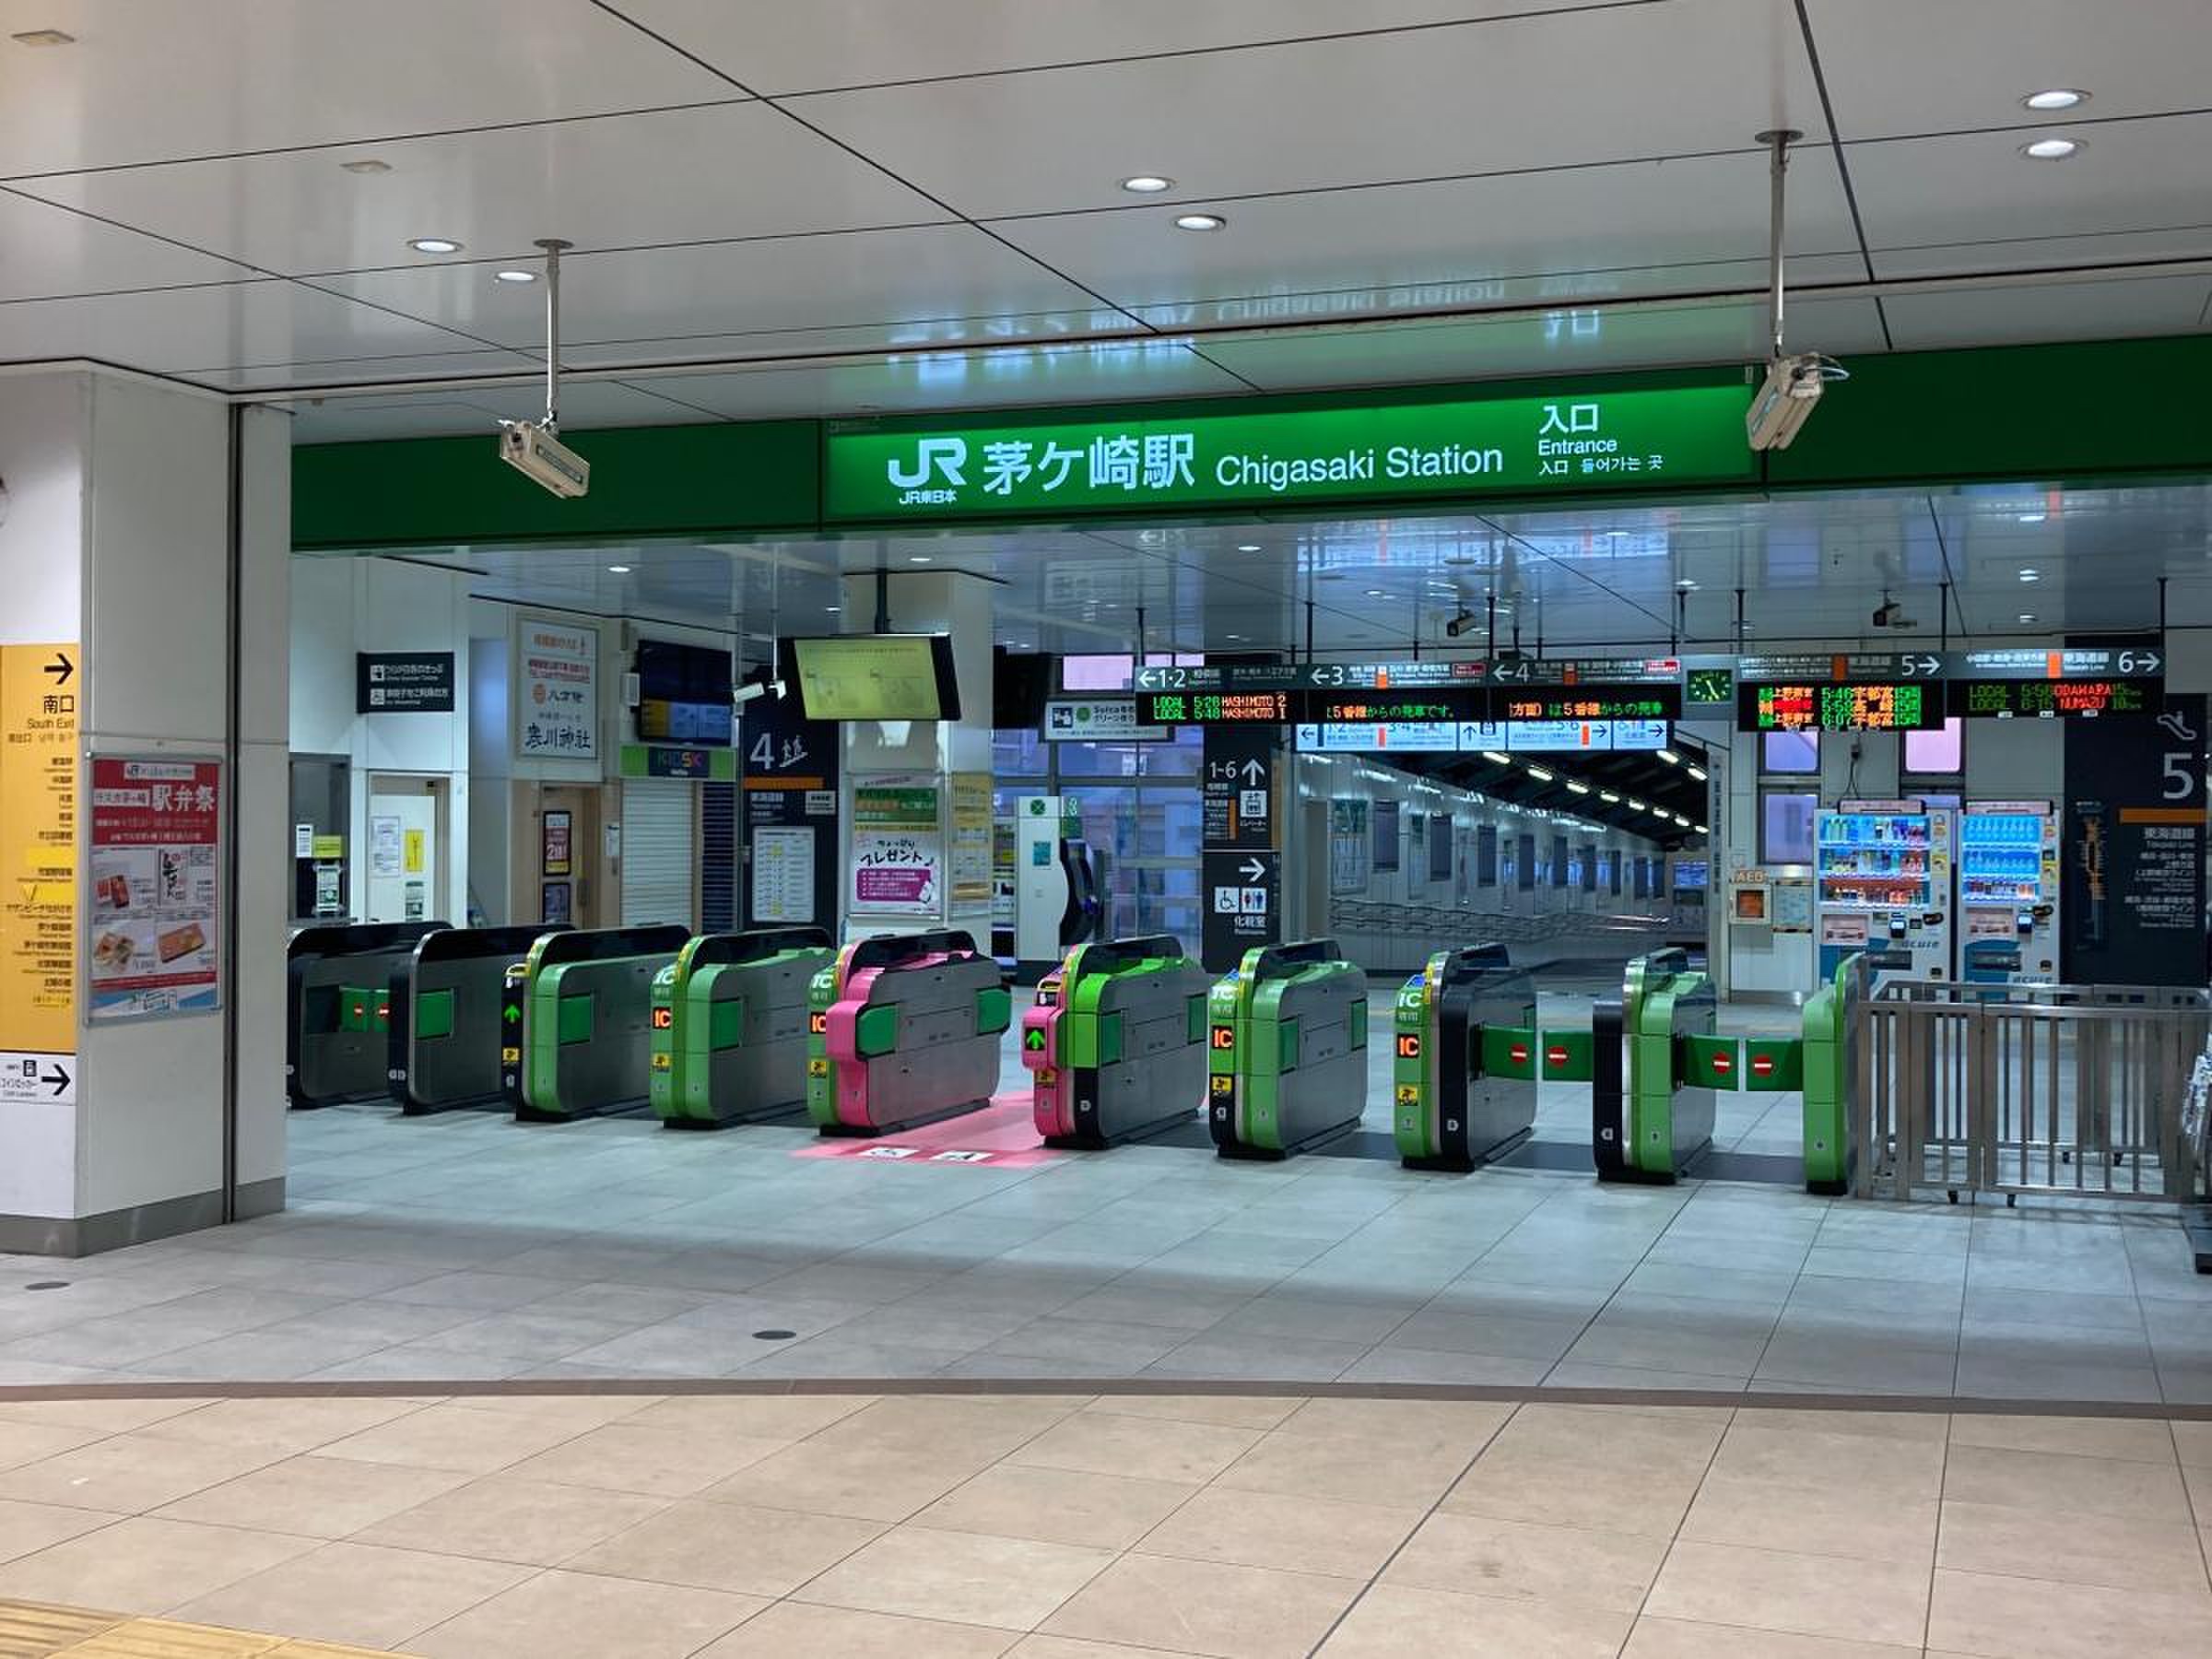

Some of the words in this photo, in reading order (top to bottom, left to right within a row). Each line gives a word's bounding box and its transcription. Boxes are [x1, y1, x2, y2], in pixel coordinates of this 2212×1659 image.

[1538, 403, 1599, 435] 入口
[1538, 438, 1618, 456] Entrance
[888, 437, 967, 488] JR
[1216, 449, 1374, 491] Chigasaki
[1386, 444, 1503, 478] Station
[1538, 459, 1568, 476] 入口
[1581, 456, 1641, 473] 들어가는
[1648, 454, 1663, 471] 곳
[899, 488, 958, 505] JR東日本
[1901, 654, 1916, 676] 5
[2118, 651, 2135, 673] 6
[1331, 666, 1343, 685] 3
[1516, 663, 1530, 683] 4
[43, 695, 75, 714] 南口
[1221, 696, 1274, 707] HASHIMOTO
[1277, 695, 1288, 707] 2
[1221, 708, 1275, 719] HASHIMOTO
[1279, 708, 1286, 719] 1
[28, 718, 53, 729] South
[656, 751, 705, 769] KIOSK
[749, 732, 775, 770] 4
[1209, 760, 1237, 779] 1-6
[2162, 752, 2194, 799] 5
[152, 783, 216, 812] 駅弁祭
[860, 849, 924, 866] プレゼント
[1738, 871, 1764, 882] AED
[653, 968, 676, 984] IC
[811, 973, 834, 988] IC
[1398, 992, 1422, 1007] IC
[654, 1010, 671, 1028] IC
[812, 1015, 827, 1032] IC
[1214, 1030, 1233, 1048] IC
[1399, 1037, 1419, 1056] IC
